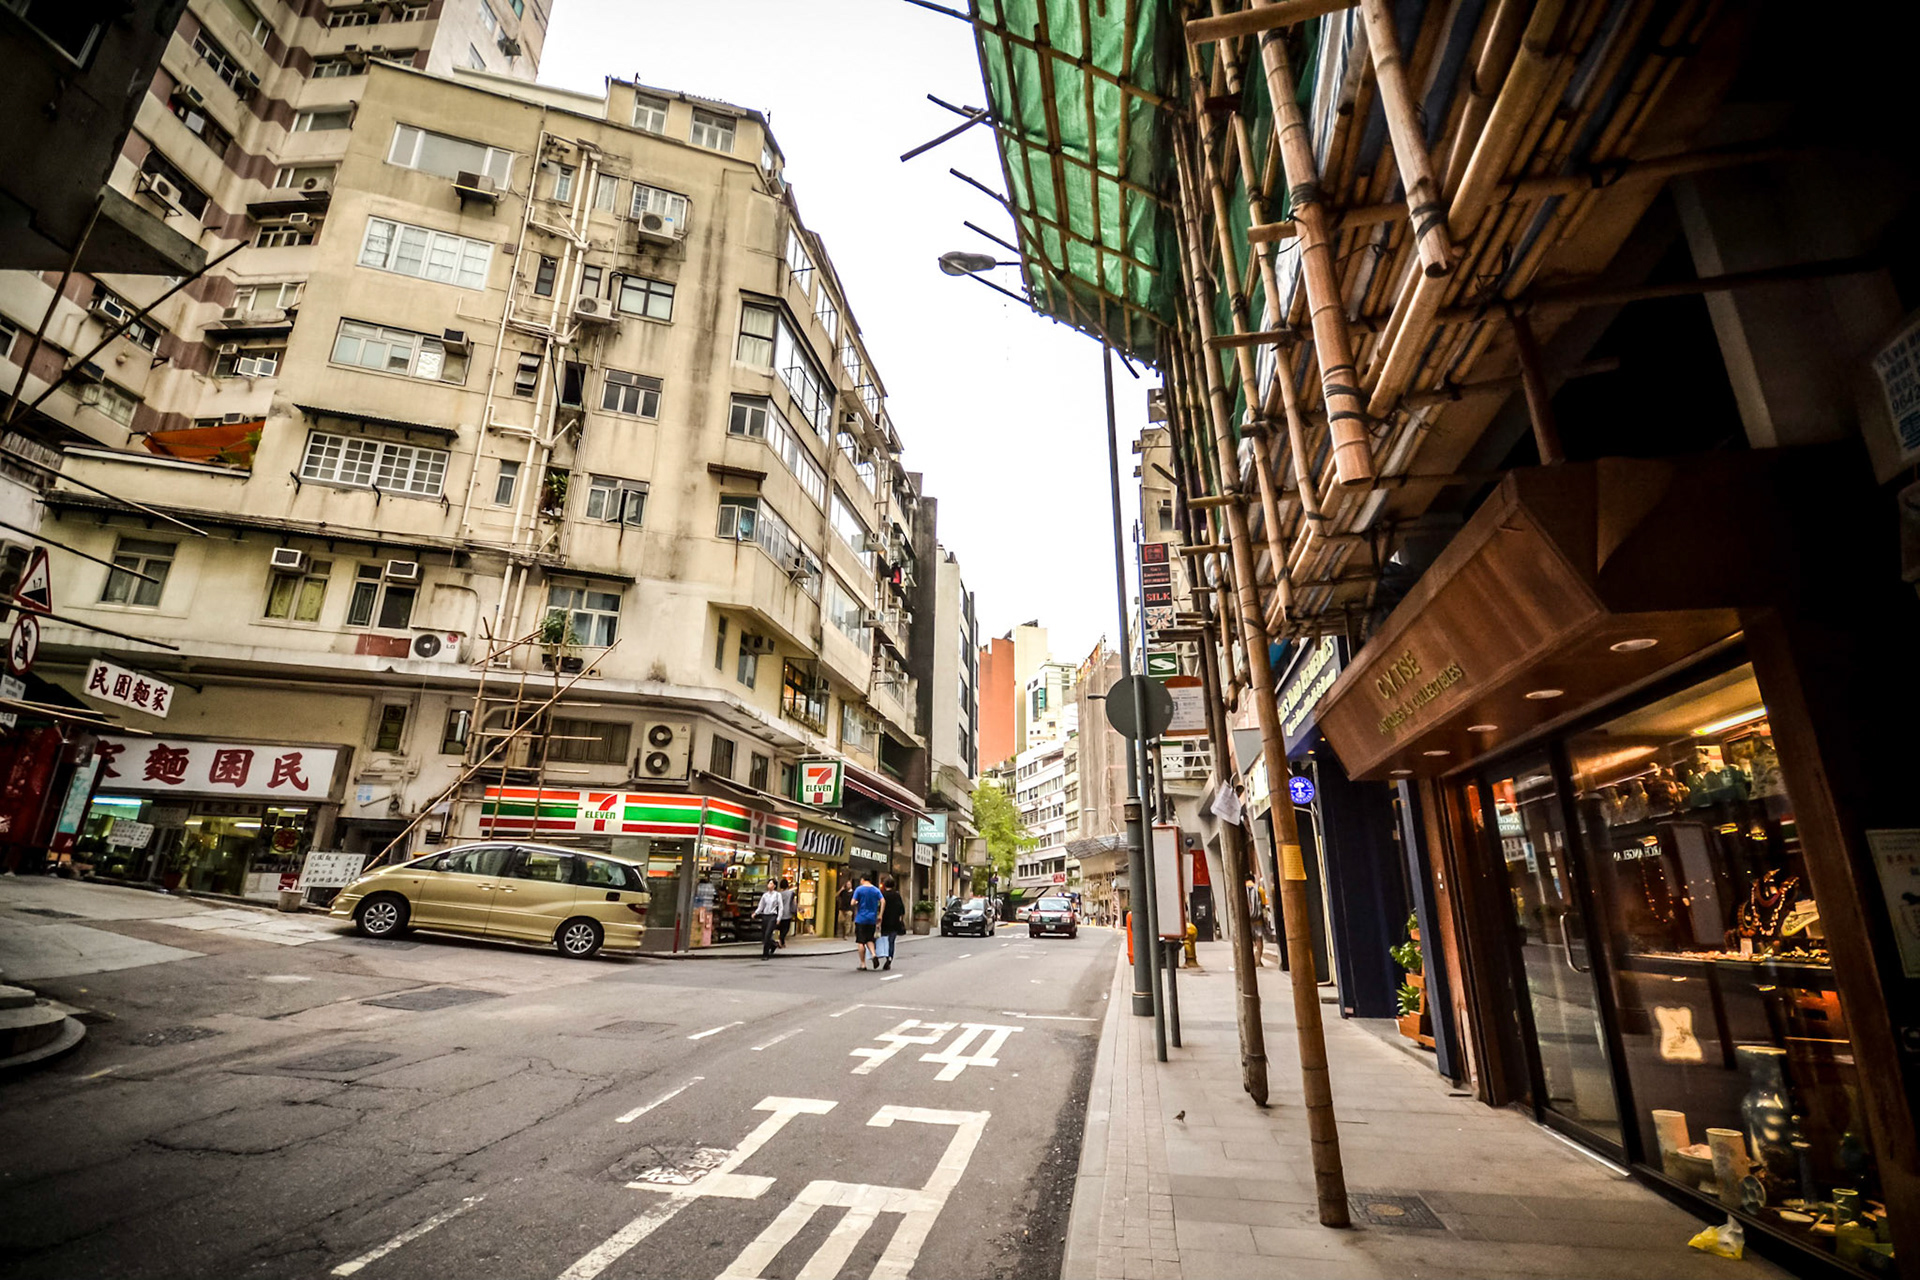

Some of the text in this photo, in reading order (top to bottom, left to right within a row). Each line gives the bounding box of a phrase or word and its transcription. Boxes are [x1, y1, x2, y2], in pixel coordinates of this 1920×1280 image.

[32, 577, 43, 589] 1:7
[1146, 592, 1171, 602] SILK
[89, 666, 169, 712] 民園麵家
[1411, 662, 1464, 709] COLLECTIBLES
[805, 784, 832, 792] ELEVEN
[585, 811, 616, 820] ELEVEN
